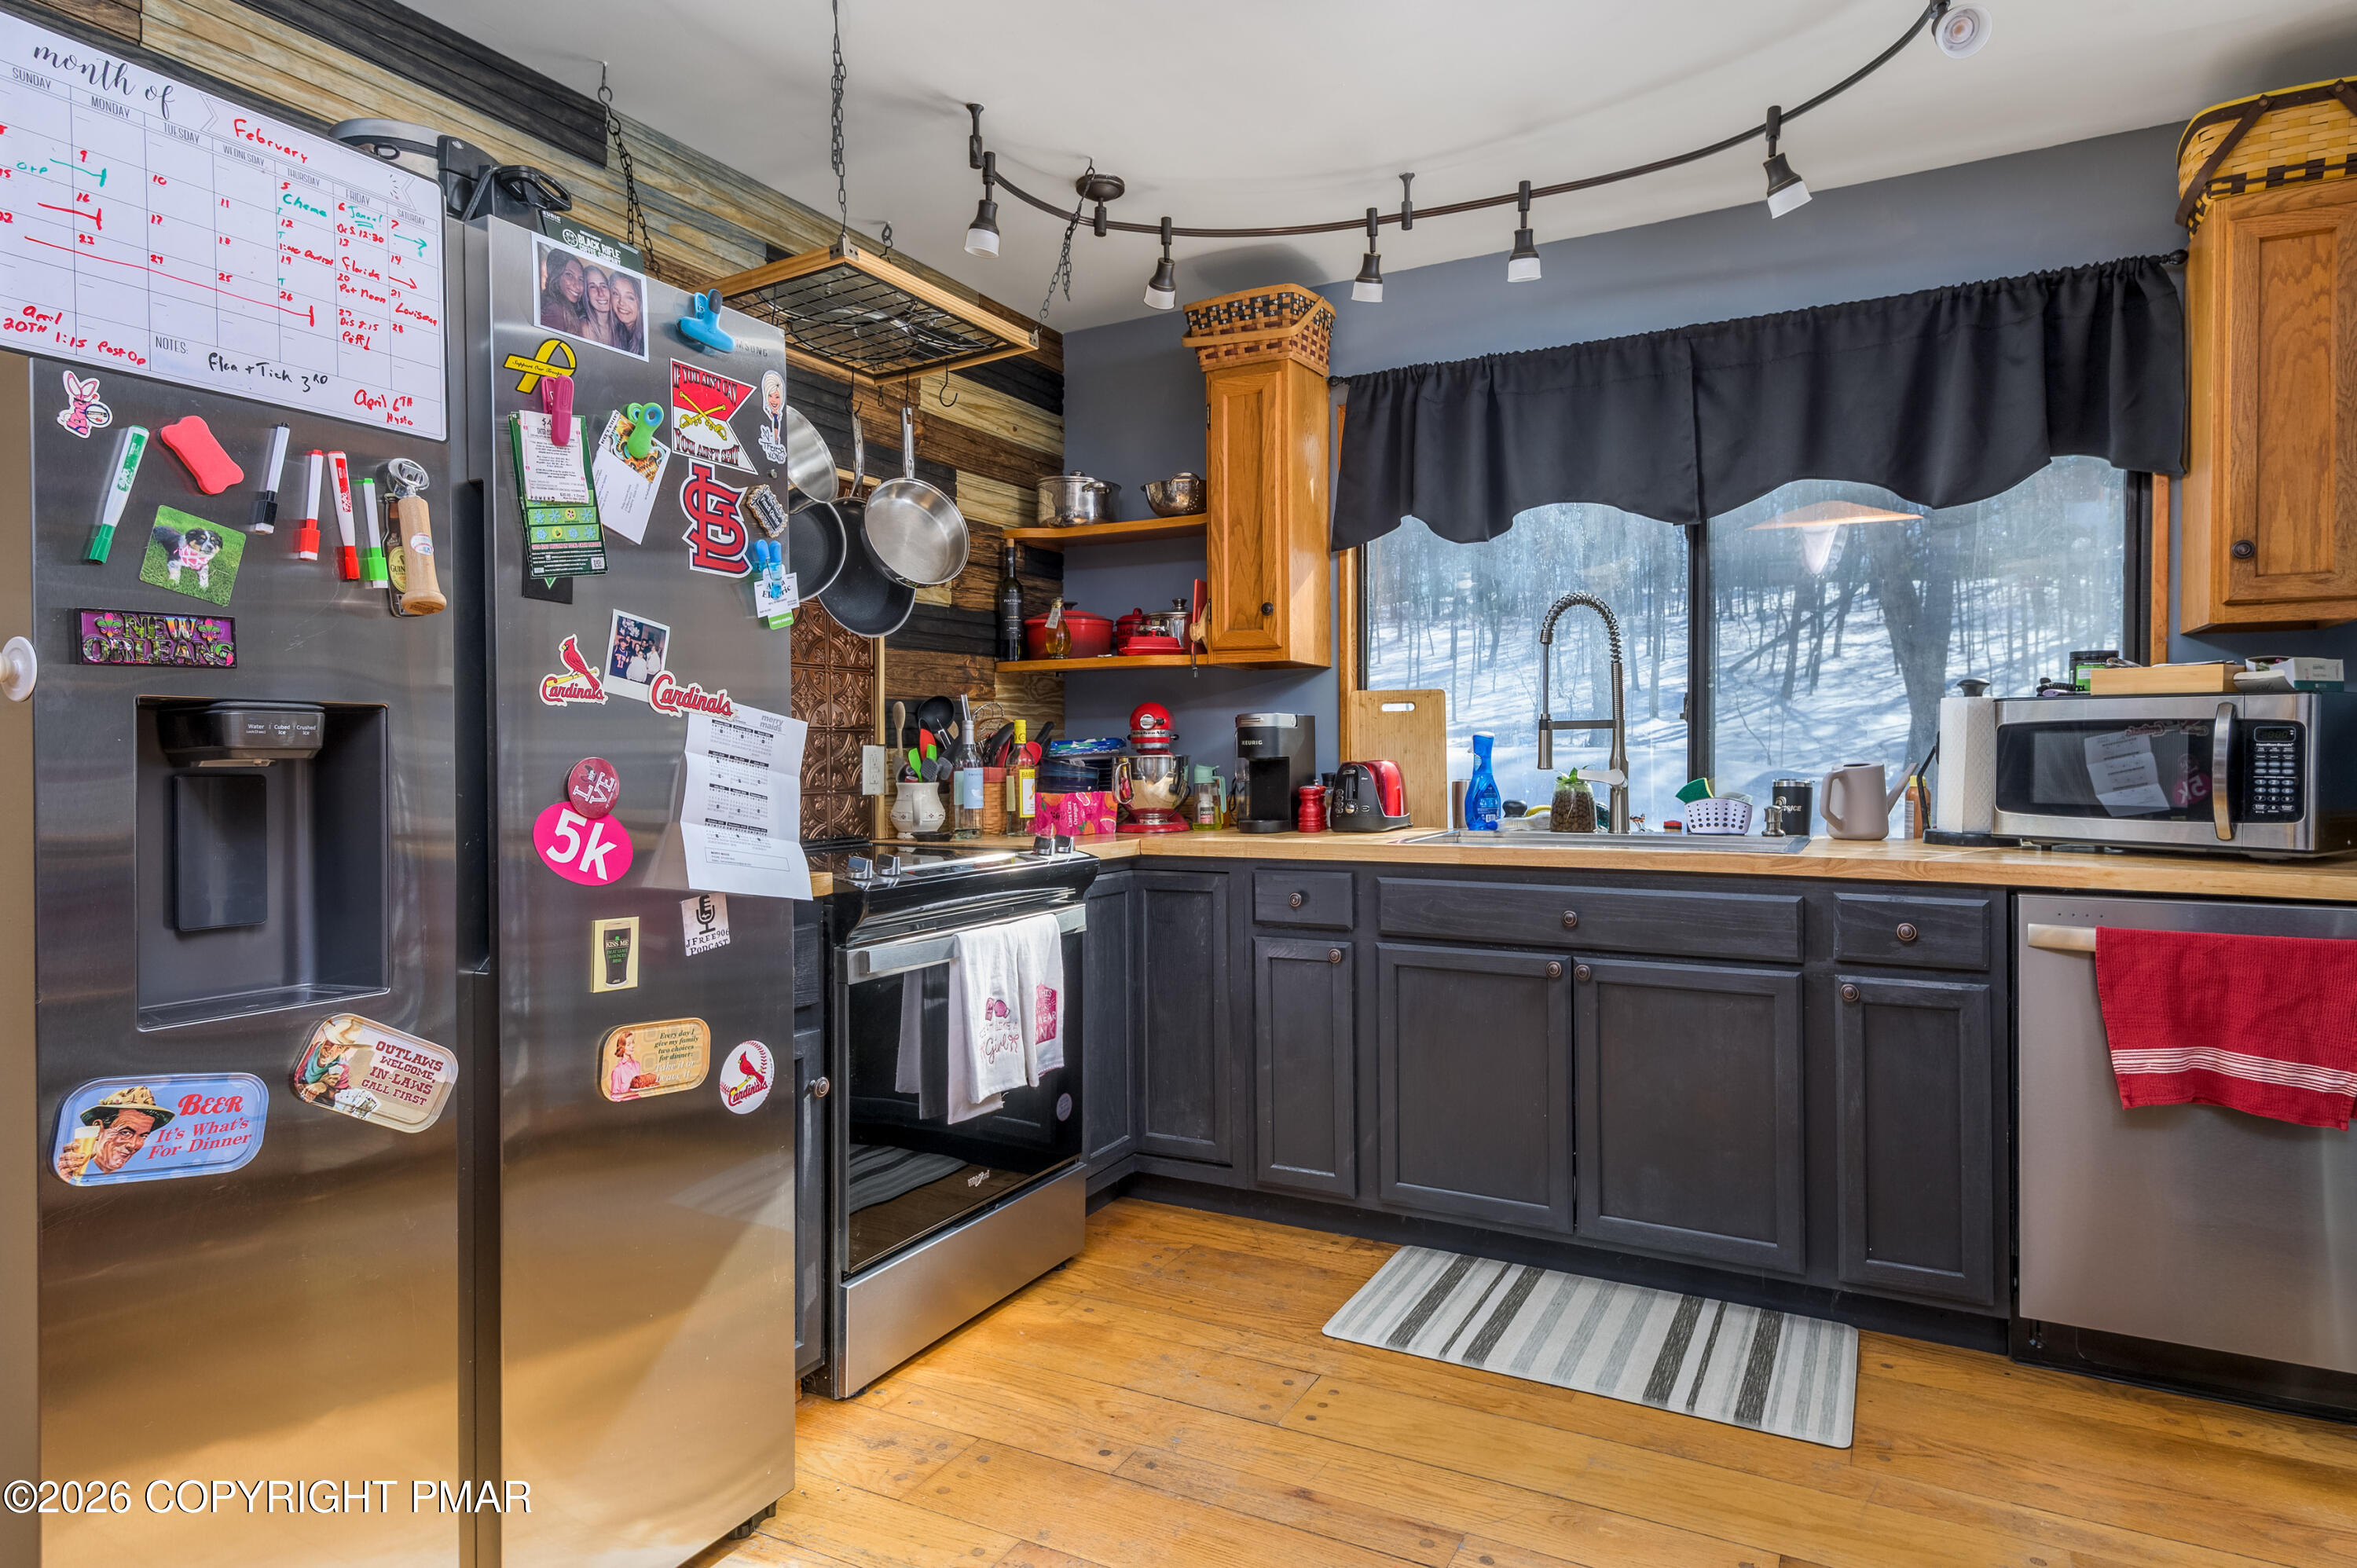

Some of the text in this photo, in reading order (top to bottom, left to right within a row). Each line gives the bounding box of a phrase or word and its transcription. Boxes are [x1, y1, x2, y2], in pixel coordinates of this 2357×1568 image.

[13, 68, 51, 90] SUNDAY
[34, 46, 175, 119] month of
[91, 96, 130, 119] MONDAY
[163, 123, 200, 144] TUESDAY
[233, 119, 308, 163] February
[80, 150, 87, 163] 9
[223, 144, 264, 167] WEDNESDAY
[152, 174, 167, 185] 10
[287, 167, 320, 188] THURSDAY
[76, 192, 90, 203] 16
[221, 198, 229, 208] 11
[346, 189, 370, 206] FRIDAY
[338, 202, 345, 211] 6
[151, 214, 163, 225] 17
[280, 219, 294, 229] 12
[397, 208, 425, 225] SATURDAY
[79, 233, 94, 245] 23
[218, 236, 231, 245] 18
[339, 238, 350, 247] 13
[358, 230, 384, 244] 12:30
[577, 233, 600, 252] BLACK
[601, 244, 621, 259] RIFLE
[150, 255, 163, 264] 24
[280, 255, 291, 265] 19
[341, 256, 380, 280] Florida
[390, 255, 401, 265] 14
[218, 273, 233, 282] 25
[337, 273, 350, 282] 20
[280, 291, 293, 302] 26
[390, 289, 401, 298] 21
[3, 317, 47, 333] 20TH
[393, 324, 404, 333] 28
[56, 332, 87, 348] 1:15
[156, 335, 189, 354] NOTES:
[735, 339, 768, 357] MSUNG
[512, 360, 533, 369] Support
[673, 364, 738, 406] IF YOU AIN'T CAV
[354, 389, 387, 411] April
[674, 428, 739, 466] YOU AIN'T SHIT
[122, 614, 196, 640] NEW
[82, 635, 234, 666] ORLEANS
[542, 676, 605, 702] Cardinals
[652, 674, 734, 716] Cardinals
[760, 721, 782, 732] maids
[761, 715, 784, 727] merry
[546, 808, 618, 881] 5k
[1036, 1024, 1056, 1042] INK
[654, 1040, 668, 1049] give
[679, 1036, 698, 1045] family
[376, 1041, 444, 1072] OUTLAWS
[380, 1056, 436, 1083] WELCOME,
[654, 1062, 676, 1072] Take
[369, 1066, 433, 1095] IN-LAWS
[361, 1079, 427, 1106] CALL FIRST
[728, 1080, 768, 1106] Cardinals
[178, 1094, 244, 1116] BEER
[155, 1117, 250, 1144] It's What's
[146, 1134, 252, 1160] For Dinner
